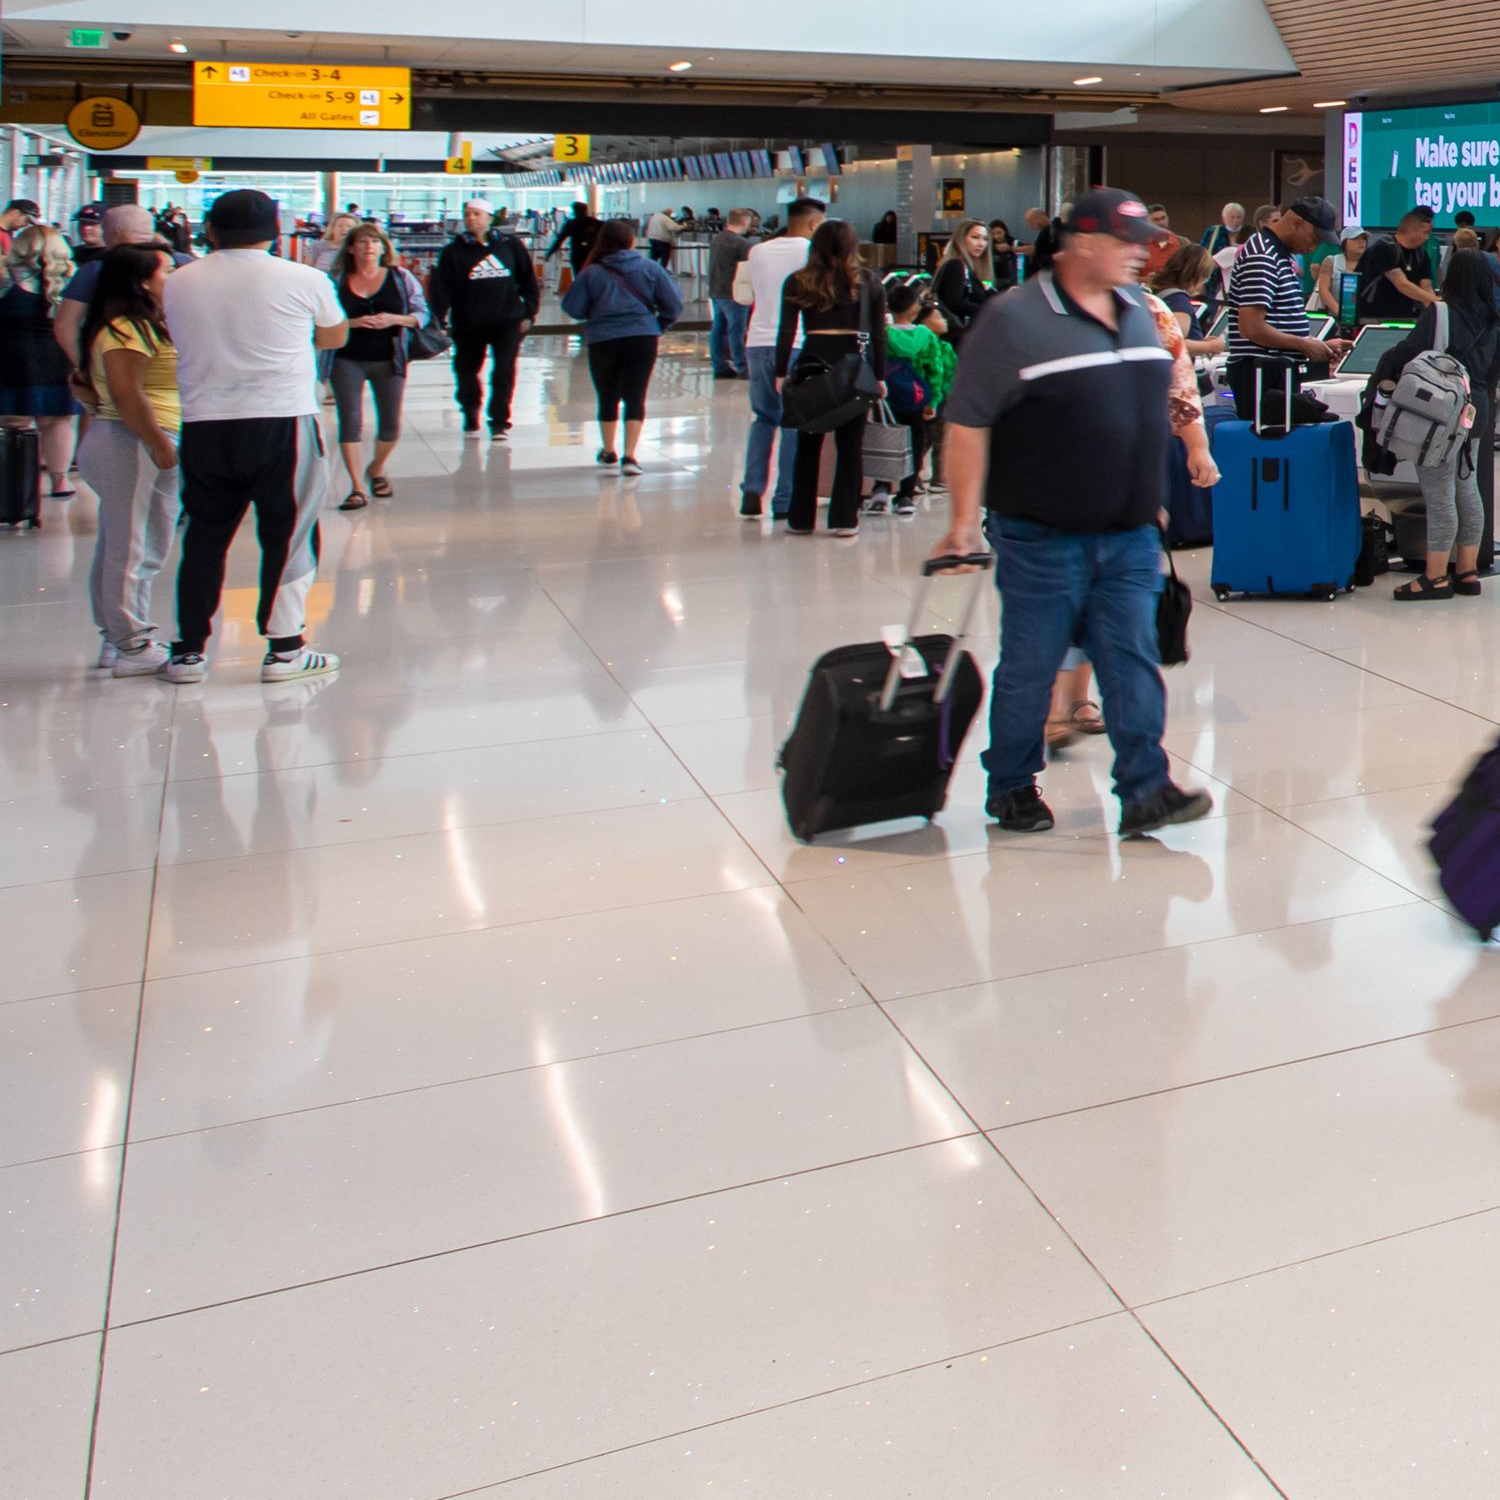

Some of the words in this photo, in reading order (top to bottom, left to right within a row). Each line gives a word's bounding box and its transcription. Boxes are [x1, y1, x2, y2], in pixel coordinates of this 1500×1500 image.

[254, 69, 306, 78] Check-in
[311, 69, 341, 81] 3-4
[268, 91, 320, 100] Check-in
[325, 91, 355, 103] 5-9
[320, 112, 354, 122] Gates
[564, 136, 579, 156] 3
[1415, 135, 1458, 168] Make
[1461, 139, 1500, 167] sure
[453, 158, 465, 171] 4
[1415, 176, 1443, 214] tag
[1446, 179, 1486, 213] your
[468, 267, 512, 280] adidas
